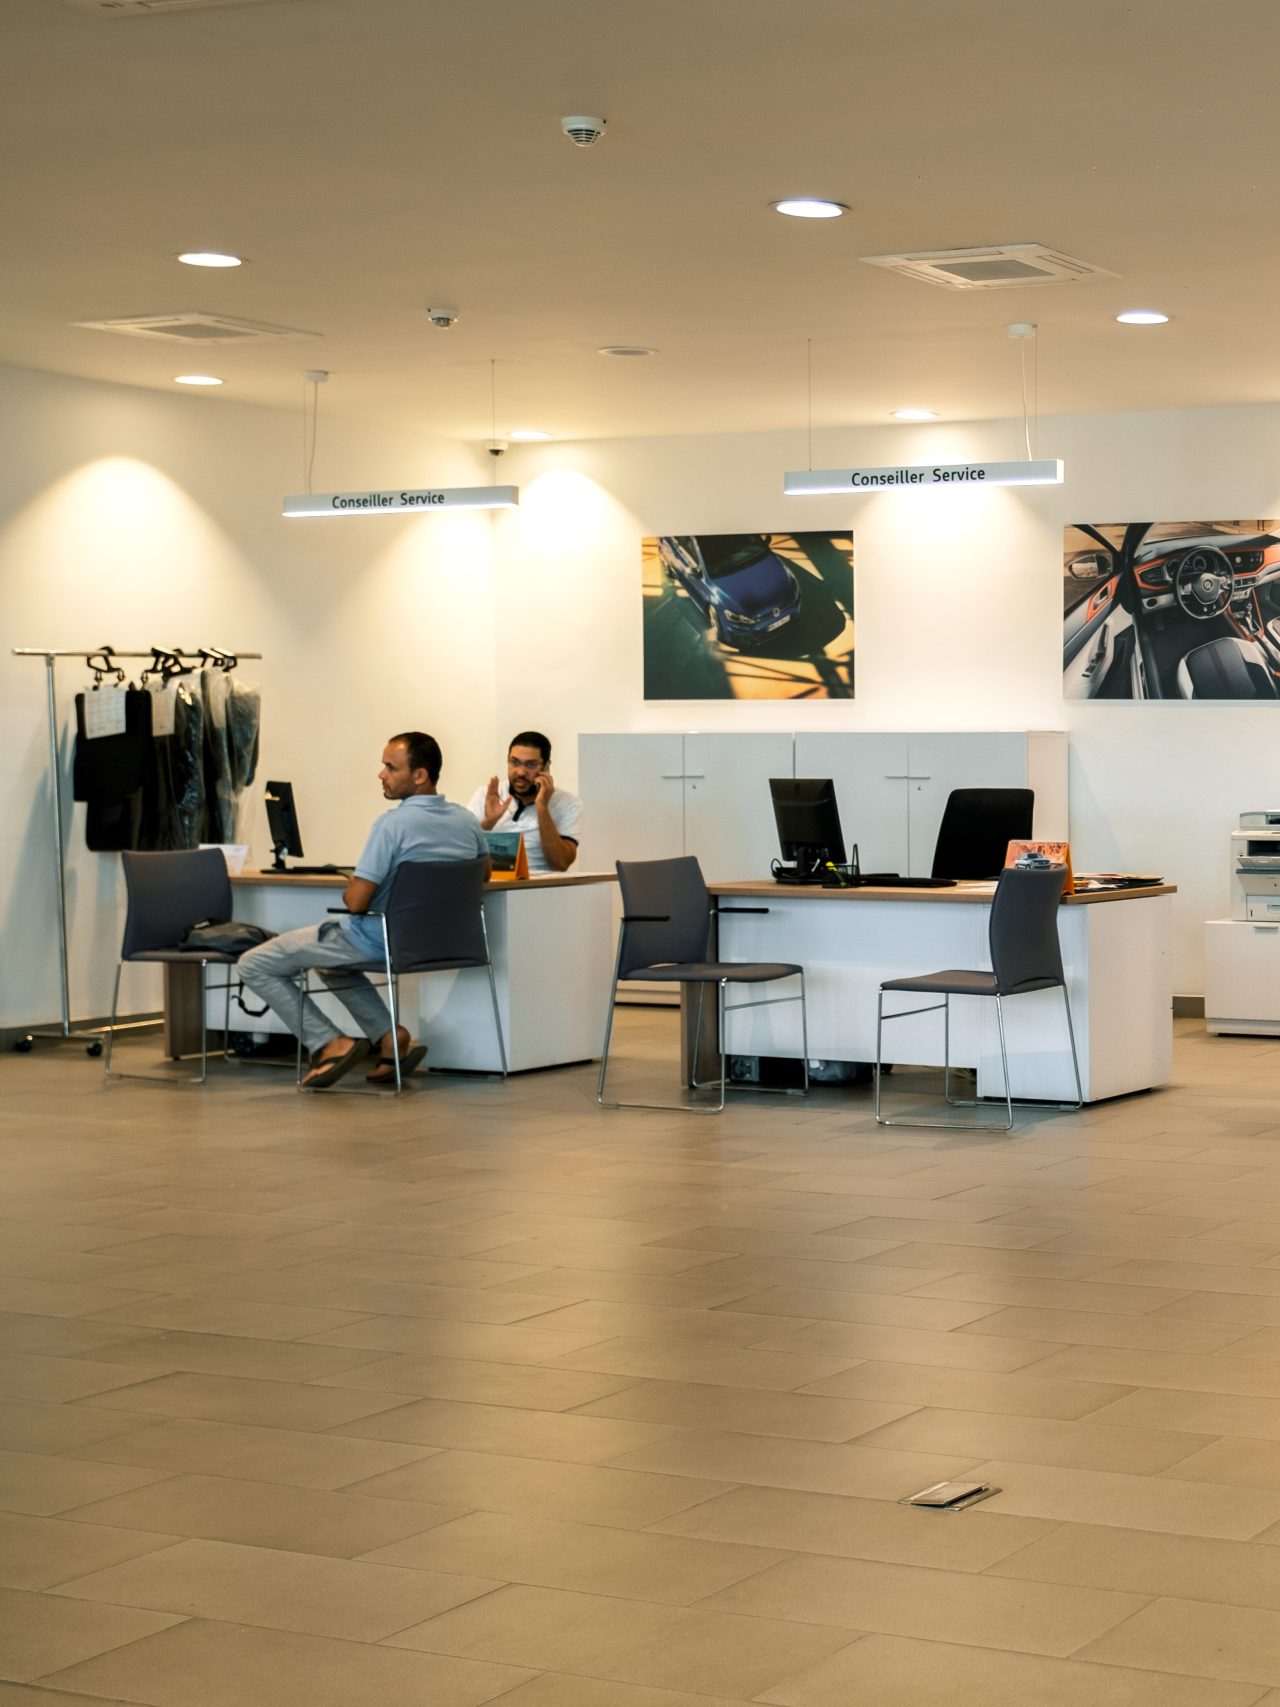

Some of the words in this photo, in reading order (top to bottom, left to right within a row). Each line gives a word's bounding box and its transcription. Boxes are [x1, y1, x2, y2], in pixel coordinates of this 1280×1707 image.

[851, 469, 925, 487] Conseiller
[932, 466, 986, 483] Service
[332, 493, 394, 509] Conseiller
[400, 491, 445, 506] Service
